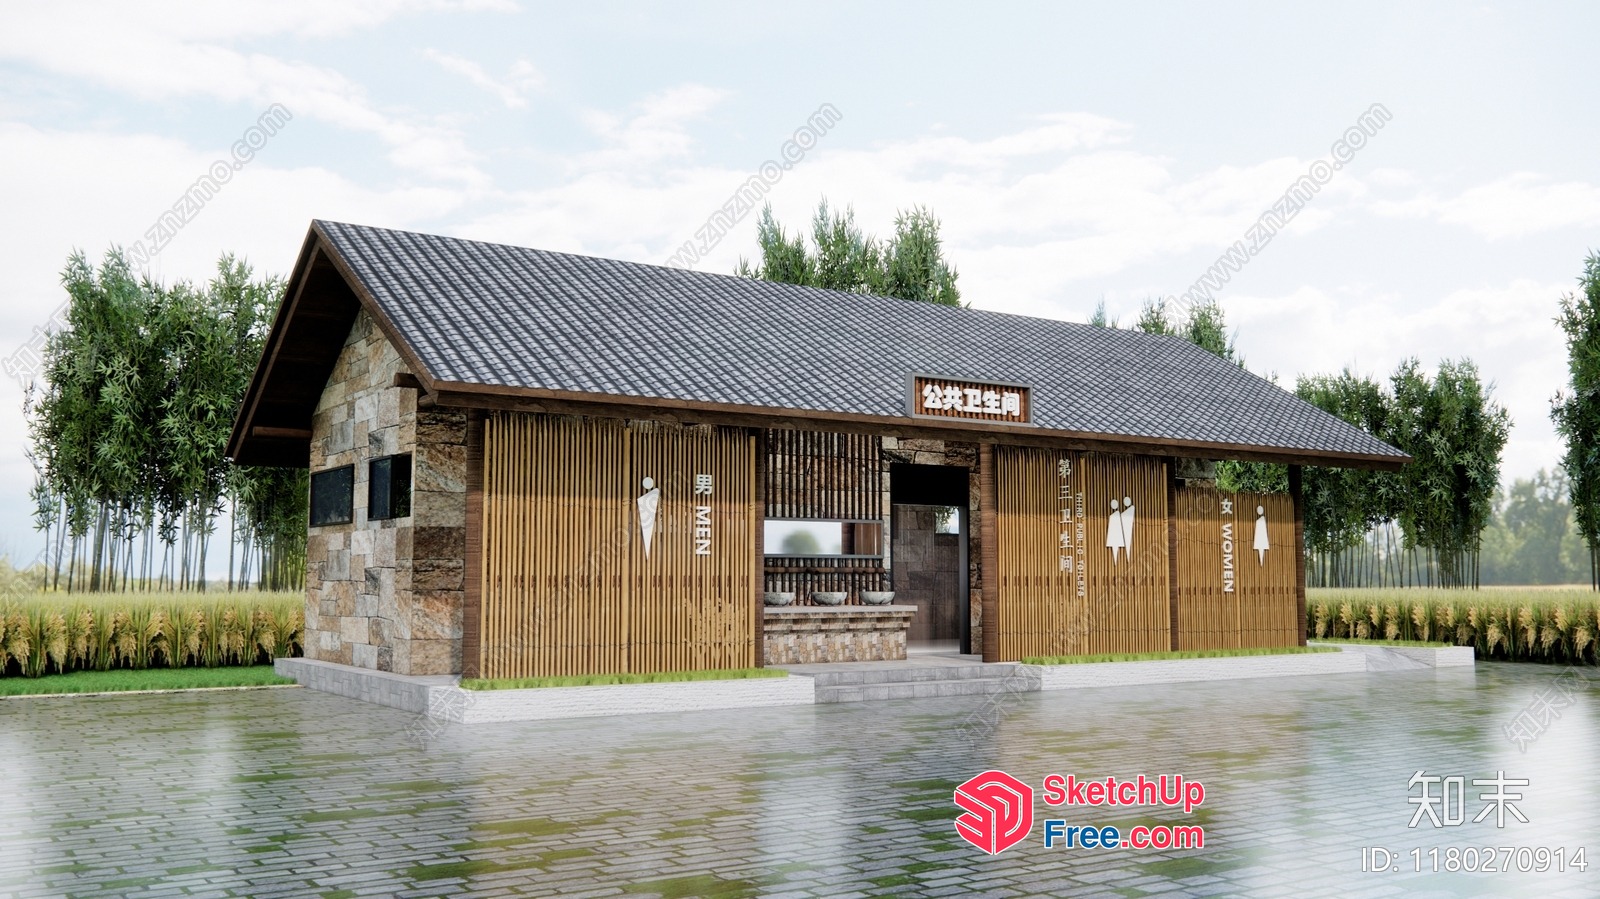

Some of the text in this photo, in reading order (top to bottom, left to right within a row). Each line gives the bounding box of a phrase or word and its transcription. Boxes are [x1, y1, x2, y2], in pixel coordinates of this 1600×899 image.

[922, 384, 1021, 417] 公共卫生间
[695, 474, 713, 555] 男 MEN
[1057, 458, 1074, 574] 第三卫生间
[1075, 492, 1083, 518] THIRD
[1220, 498, 1235, 593] 女 WOMEN
